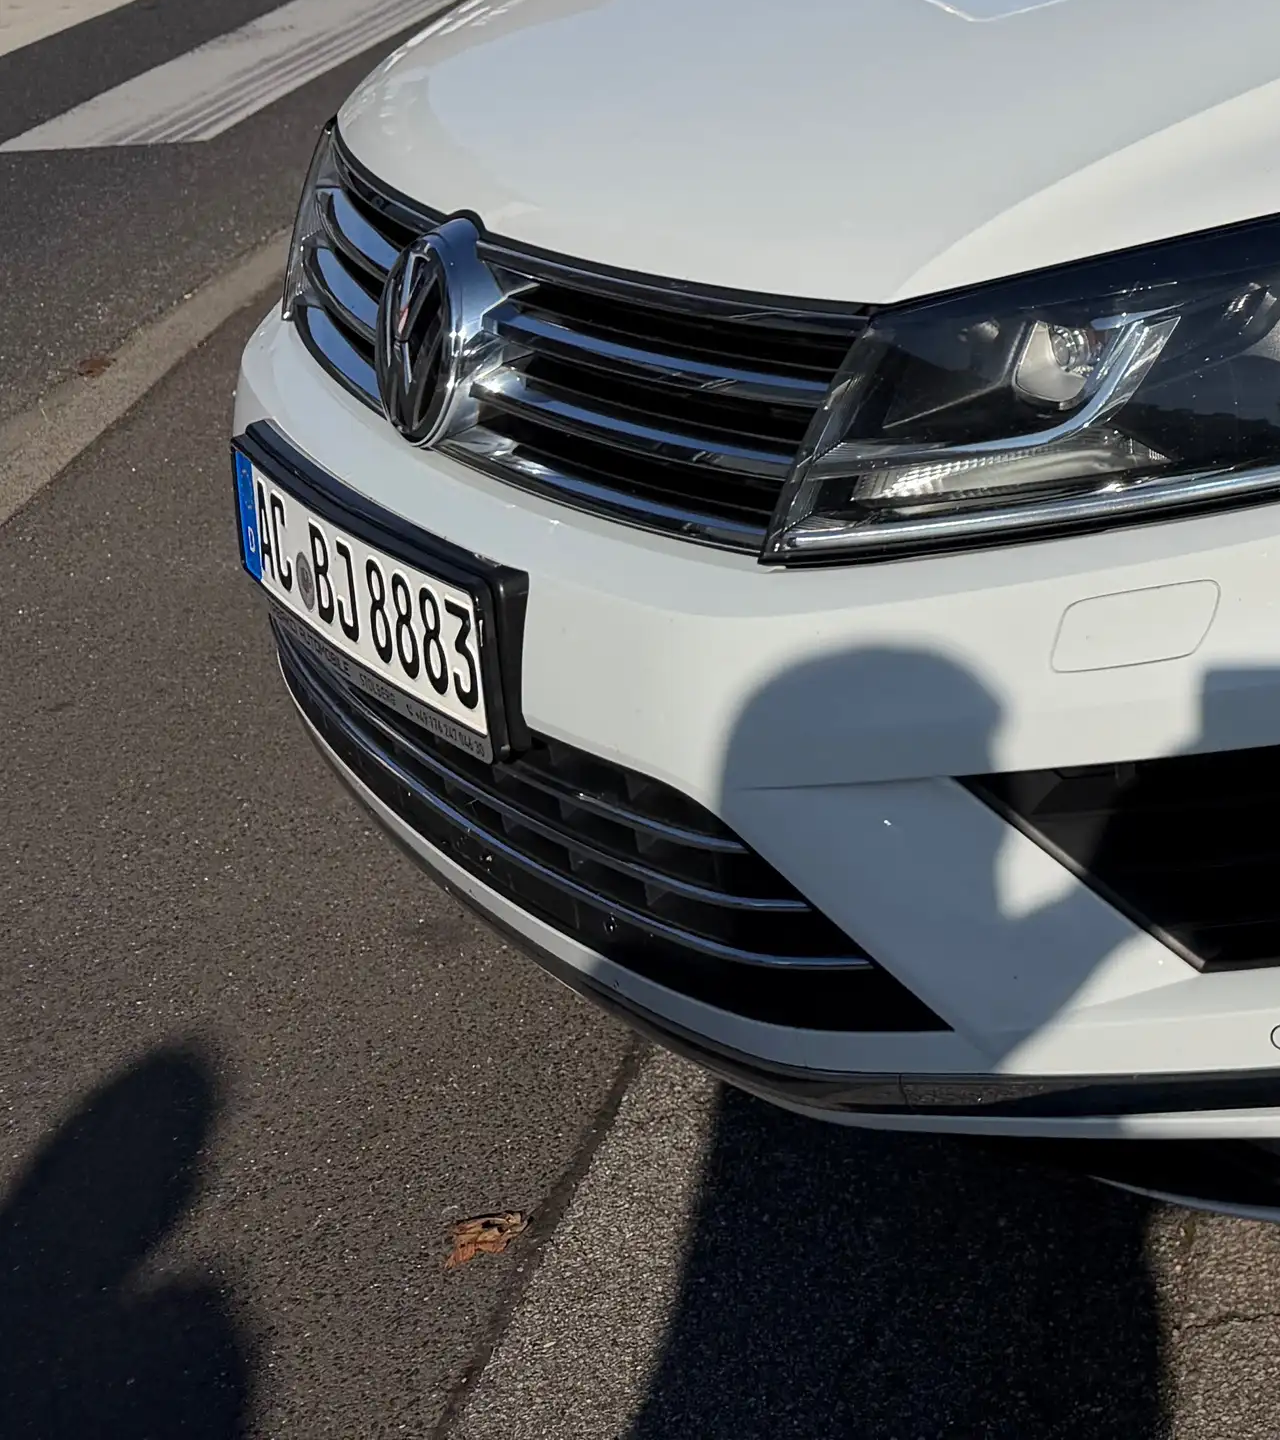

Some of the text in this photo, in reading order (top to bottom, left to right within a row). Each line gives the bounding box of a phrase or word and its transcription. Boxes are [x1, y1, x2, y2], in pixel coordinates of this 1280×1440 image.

[247, 526, 256, 553] D
[257, 479, 479, 710] AC BJ 8883
